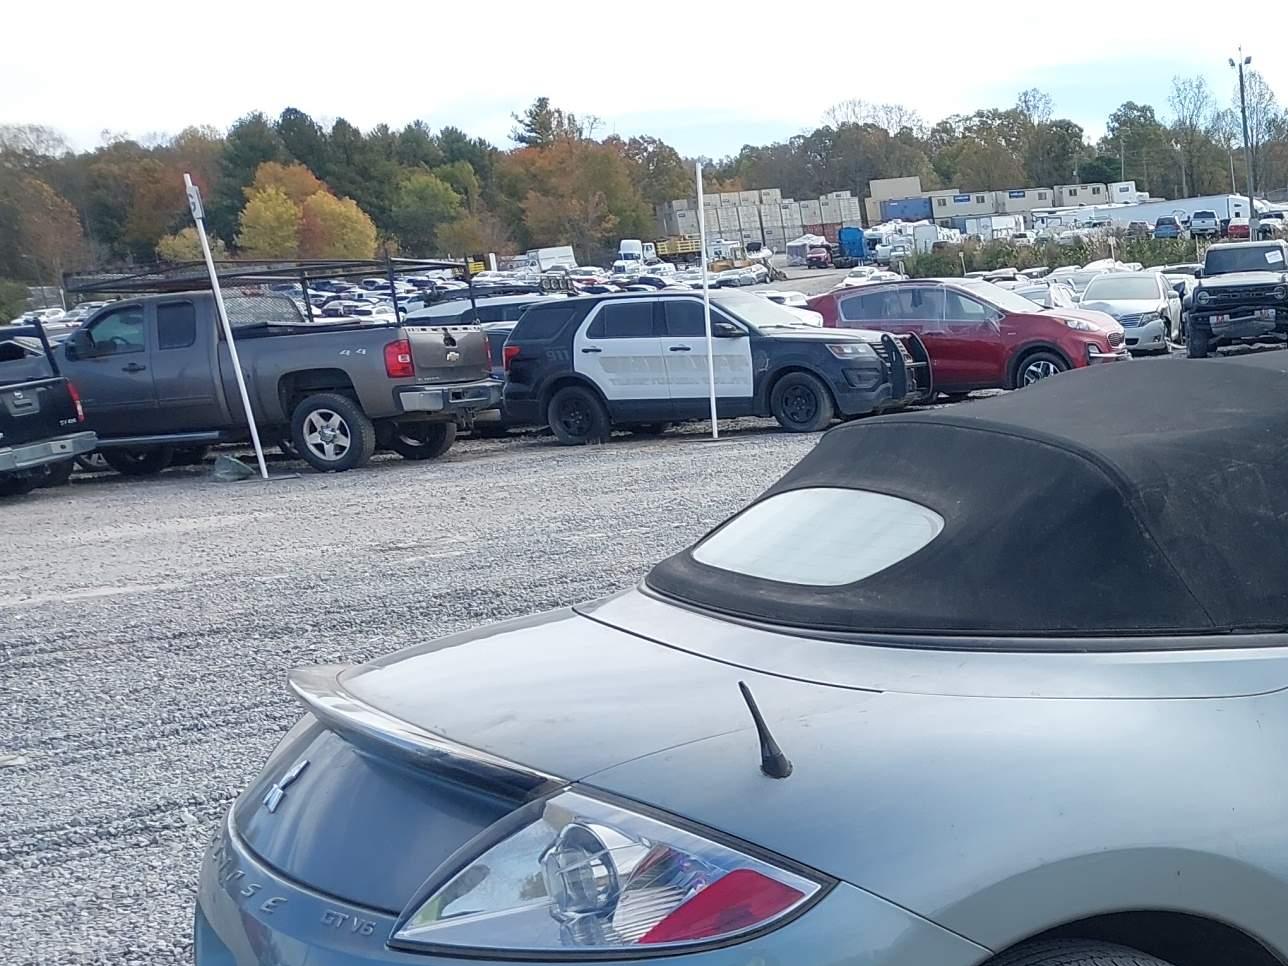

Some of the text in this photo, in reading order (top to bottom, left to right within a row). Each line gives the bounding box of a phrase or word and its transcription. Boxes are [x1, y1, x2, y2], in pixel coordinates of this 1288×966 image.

[339, 348, 367, 357] 44
[545, 350, 570, 360] 911
[320, 909, 377, 936] GT V6
